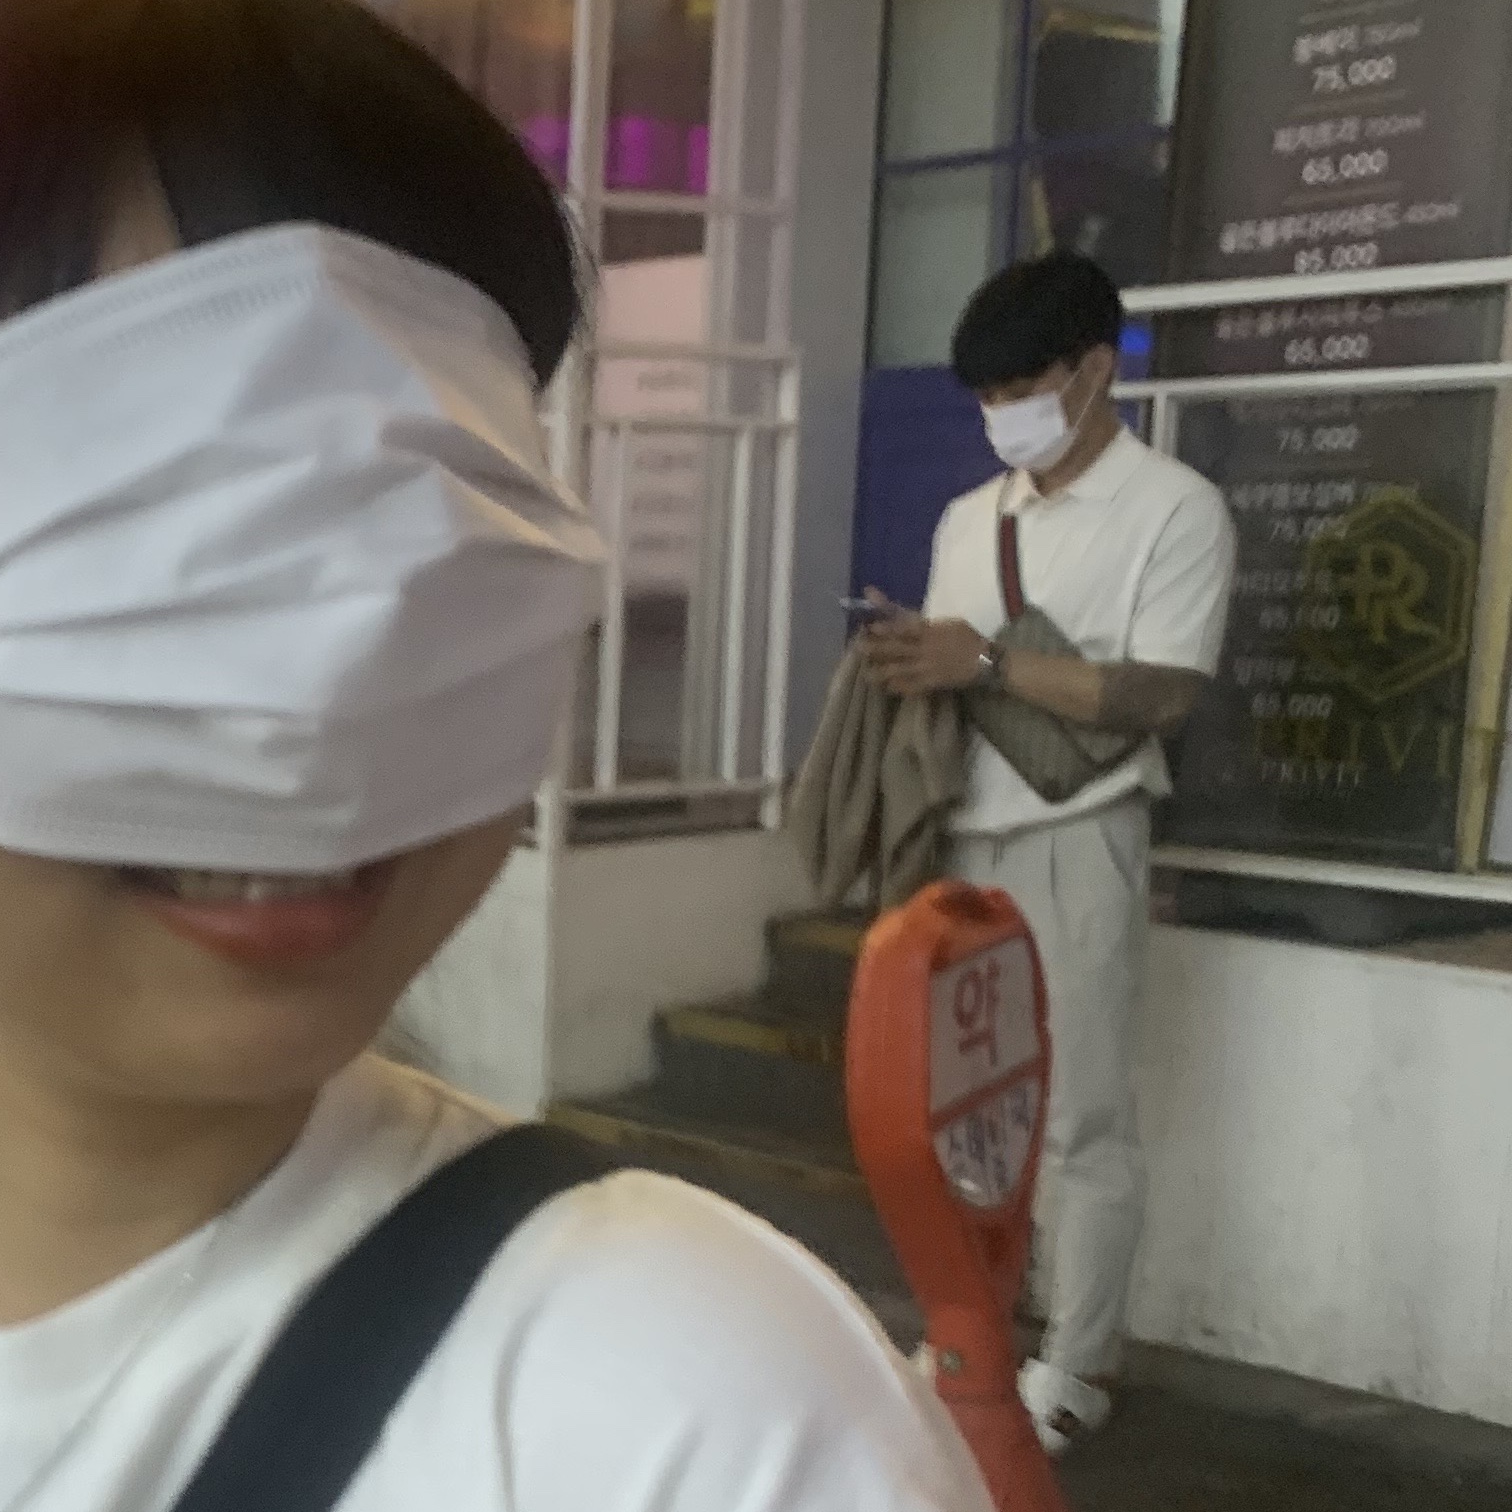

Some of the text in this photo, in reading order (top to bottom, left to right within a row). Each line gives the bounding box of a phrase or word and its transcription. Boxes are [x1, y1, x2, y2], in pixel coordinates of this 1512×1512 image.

[1313, 54, 1396, 92] 75,000
[1302, 148, 1388, 185] 65,000
[1284, 333, 1370, 365] 65,000
[1274, 424, 1359, 453] 75,000
[952, 957, 1002, 1066] 약
